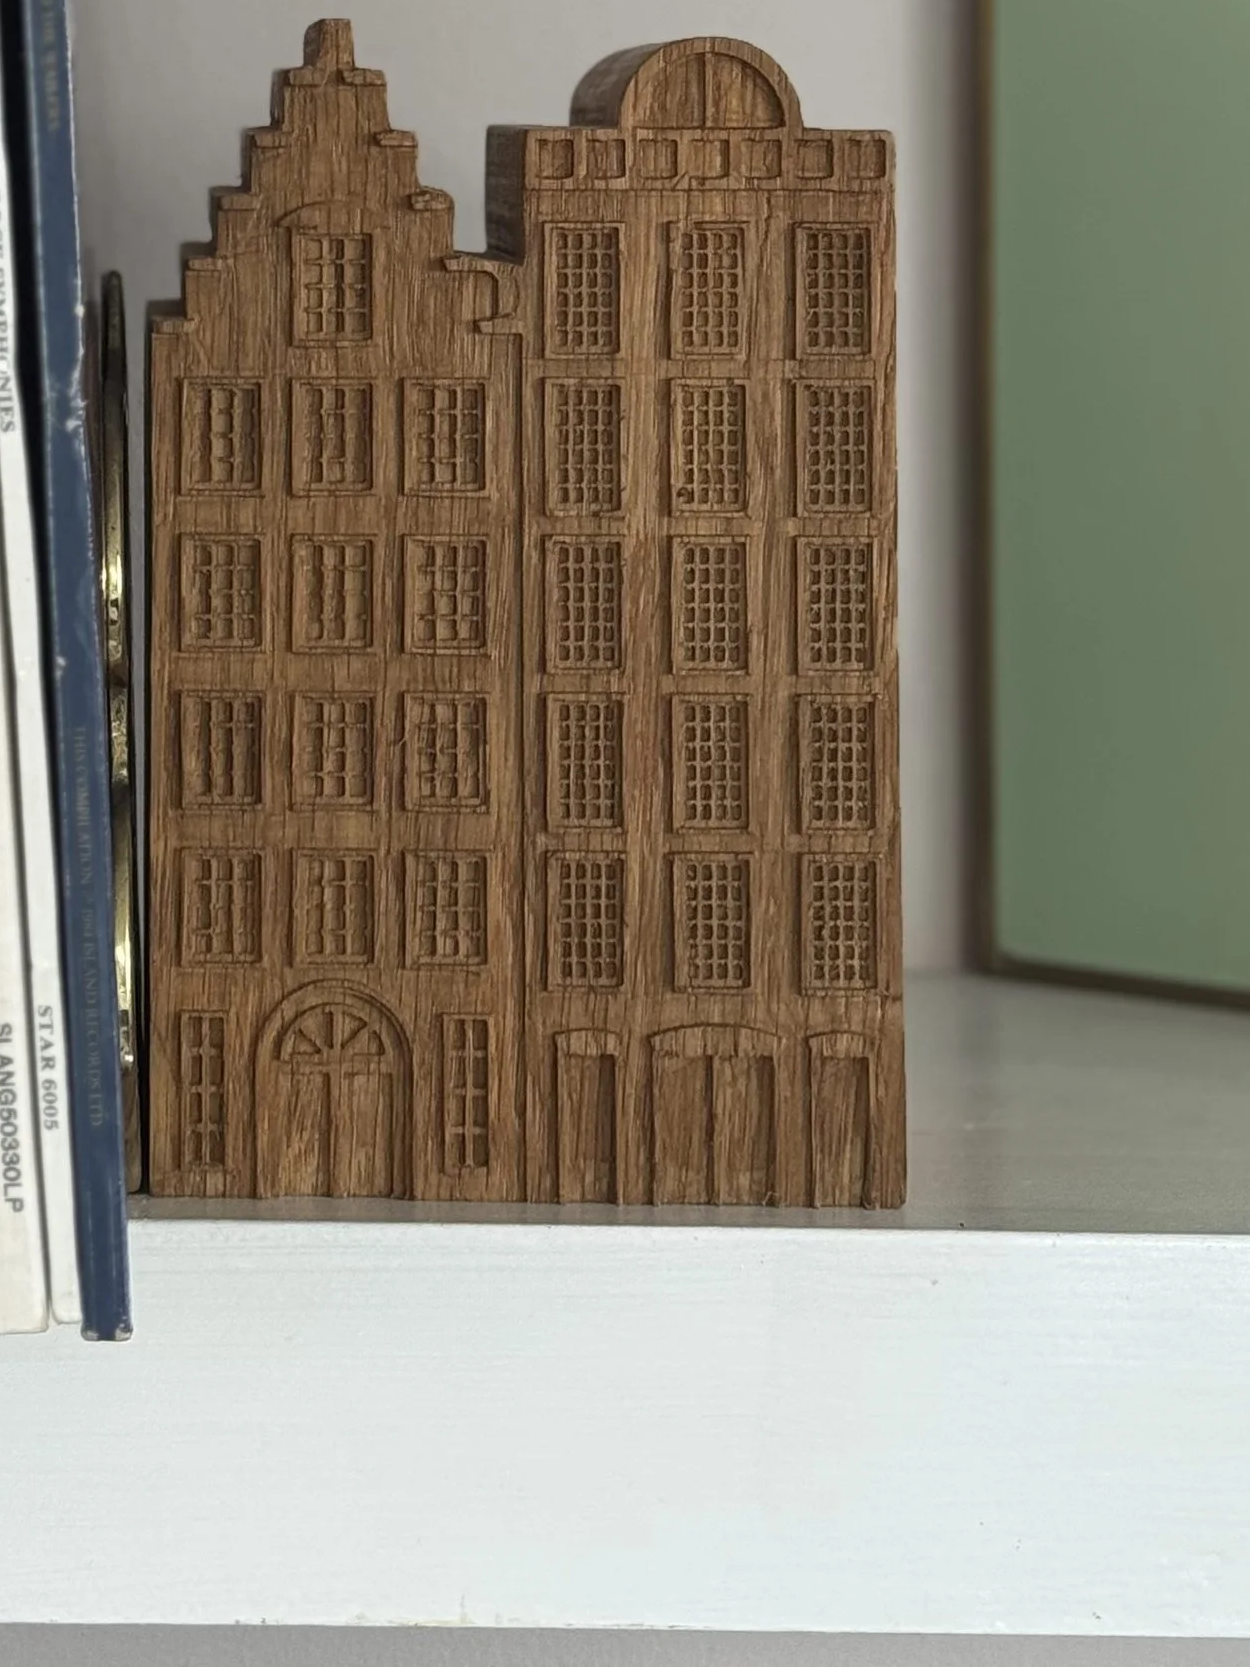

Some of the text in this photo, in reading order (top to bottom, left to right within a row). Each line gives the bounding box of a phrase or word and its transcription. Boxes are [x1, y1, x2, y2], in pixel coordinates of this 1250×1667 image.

[81, 942, 101, 1004] ISLAND
[36, 1005, 59, 1131] STAR 6005
